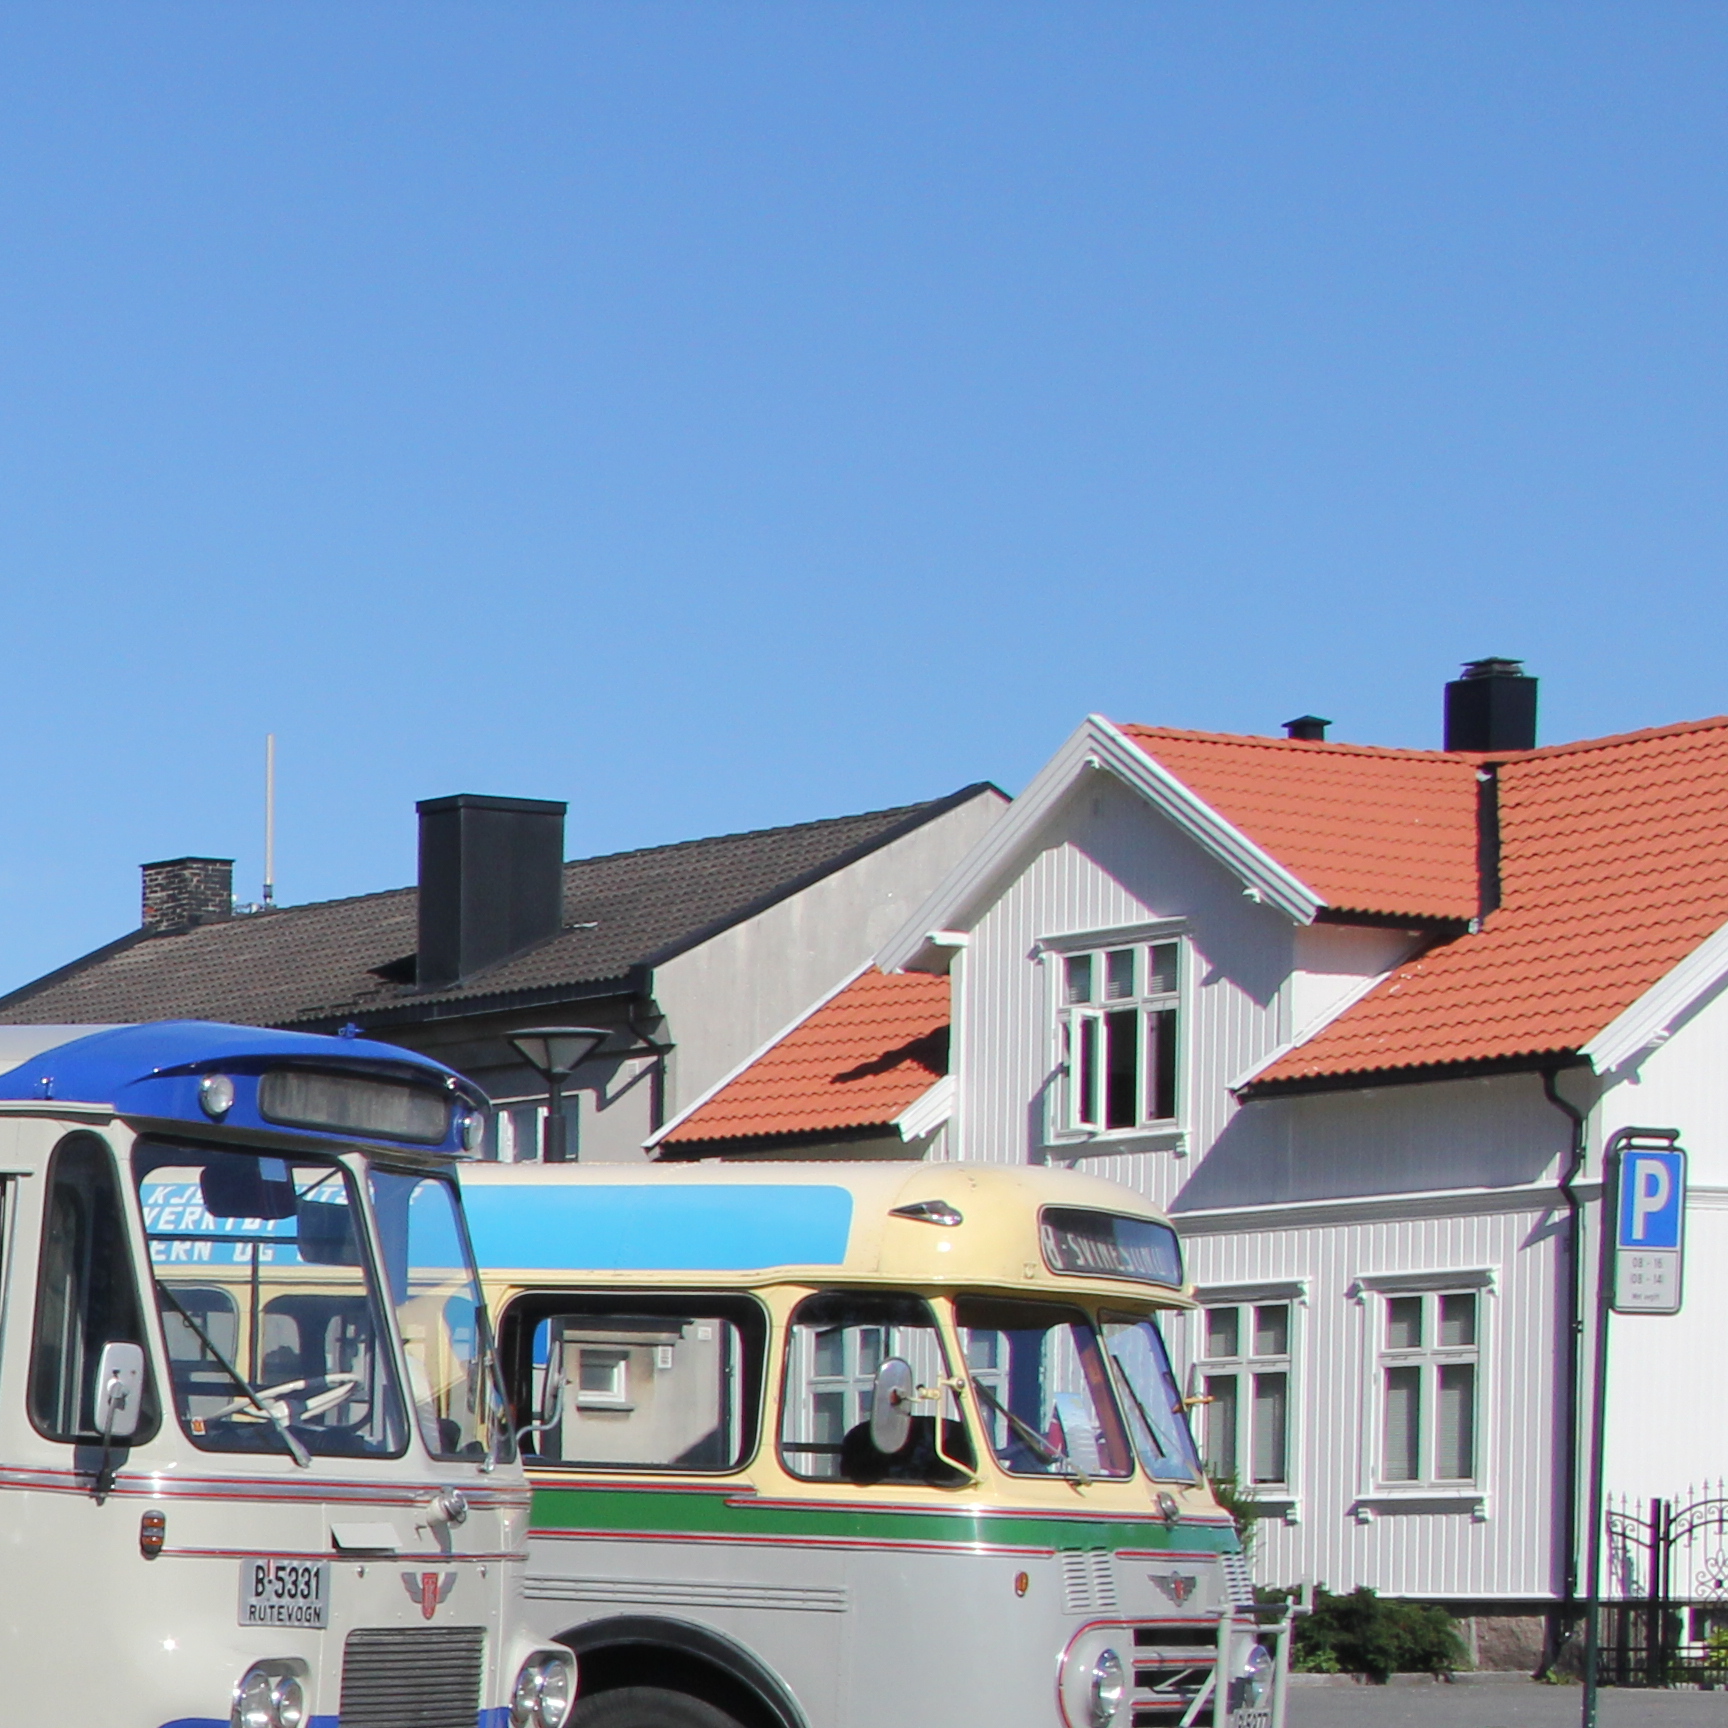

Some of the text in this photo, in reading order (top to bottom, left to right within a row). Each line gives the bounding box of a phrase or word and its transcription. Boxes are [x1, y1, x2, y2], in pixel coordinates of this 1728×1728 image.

[1631, 1158, 1670, 1241] P
[254, 1564, 320, 1600] B-5331
[248, 1604, 321, 1623] RUTEVOGN
